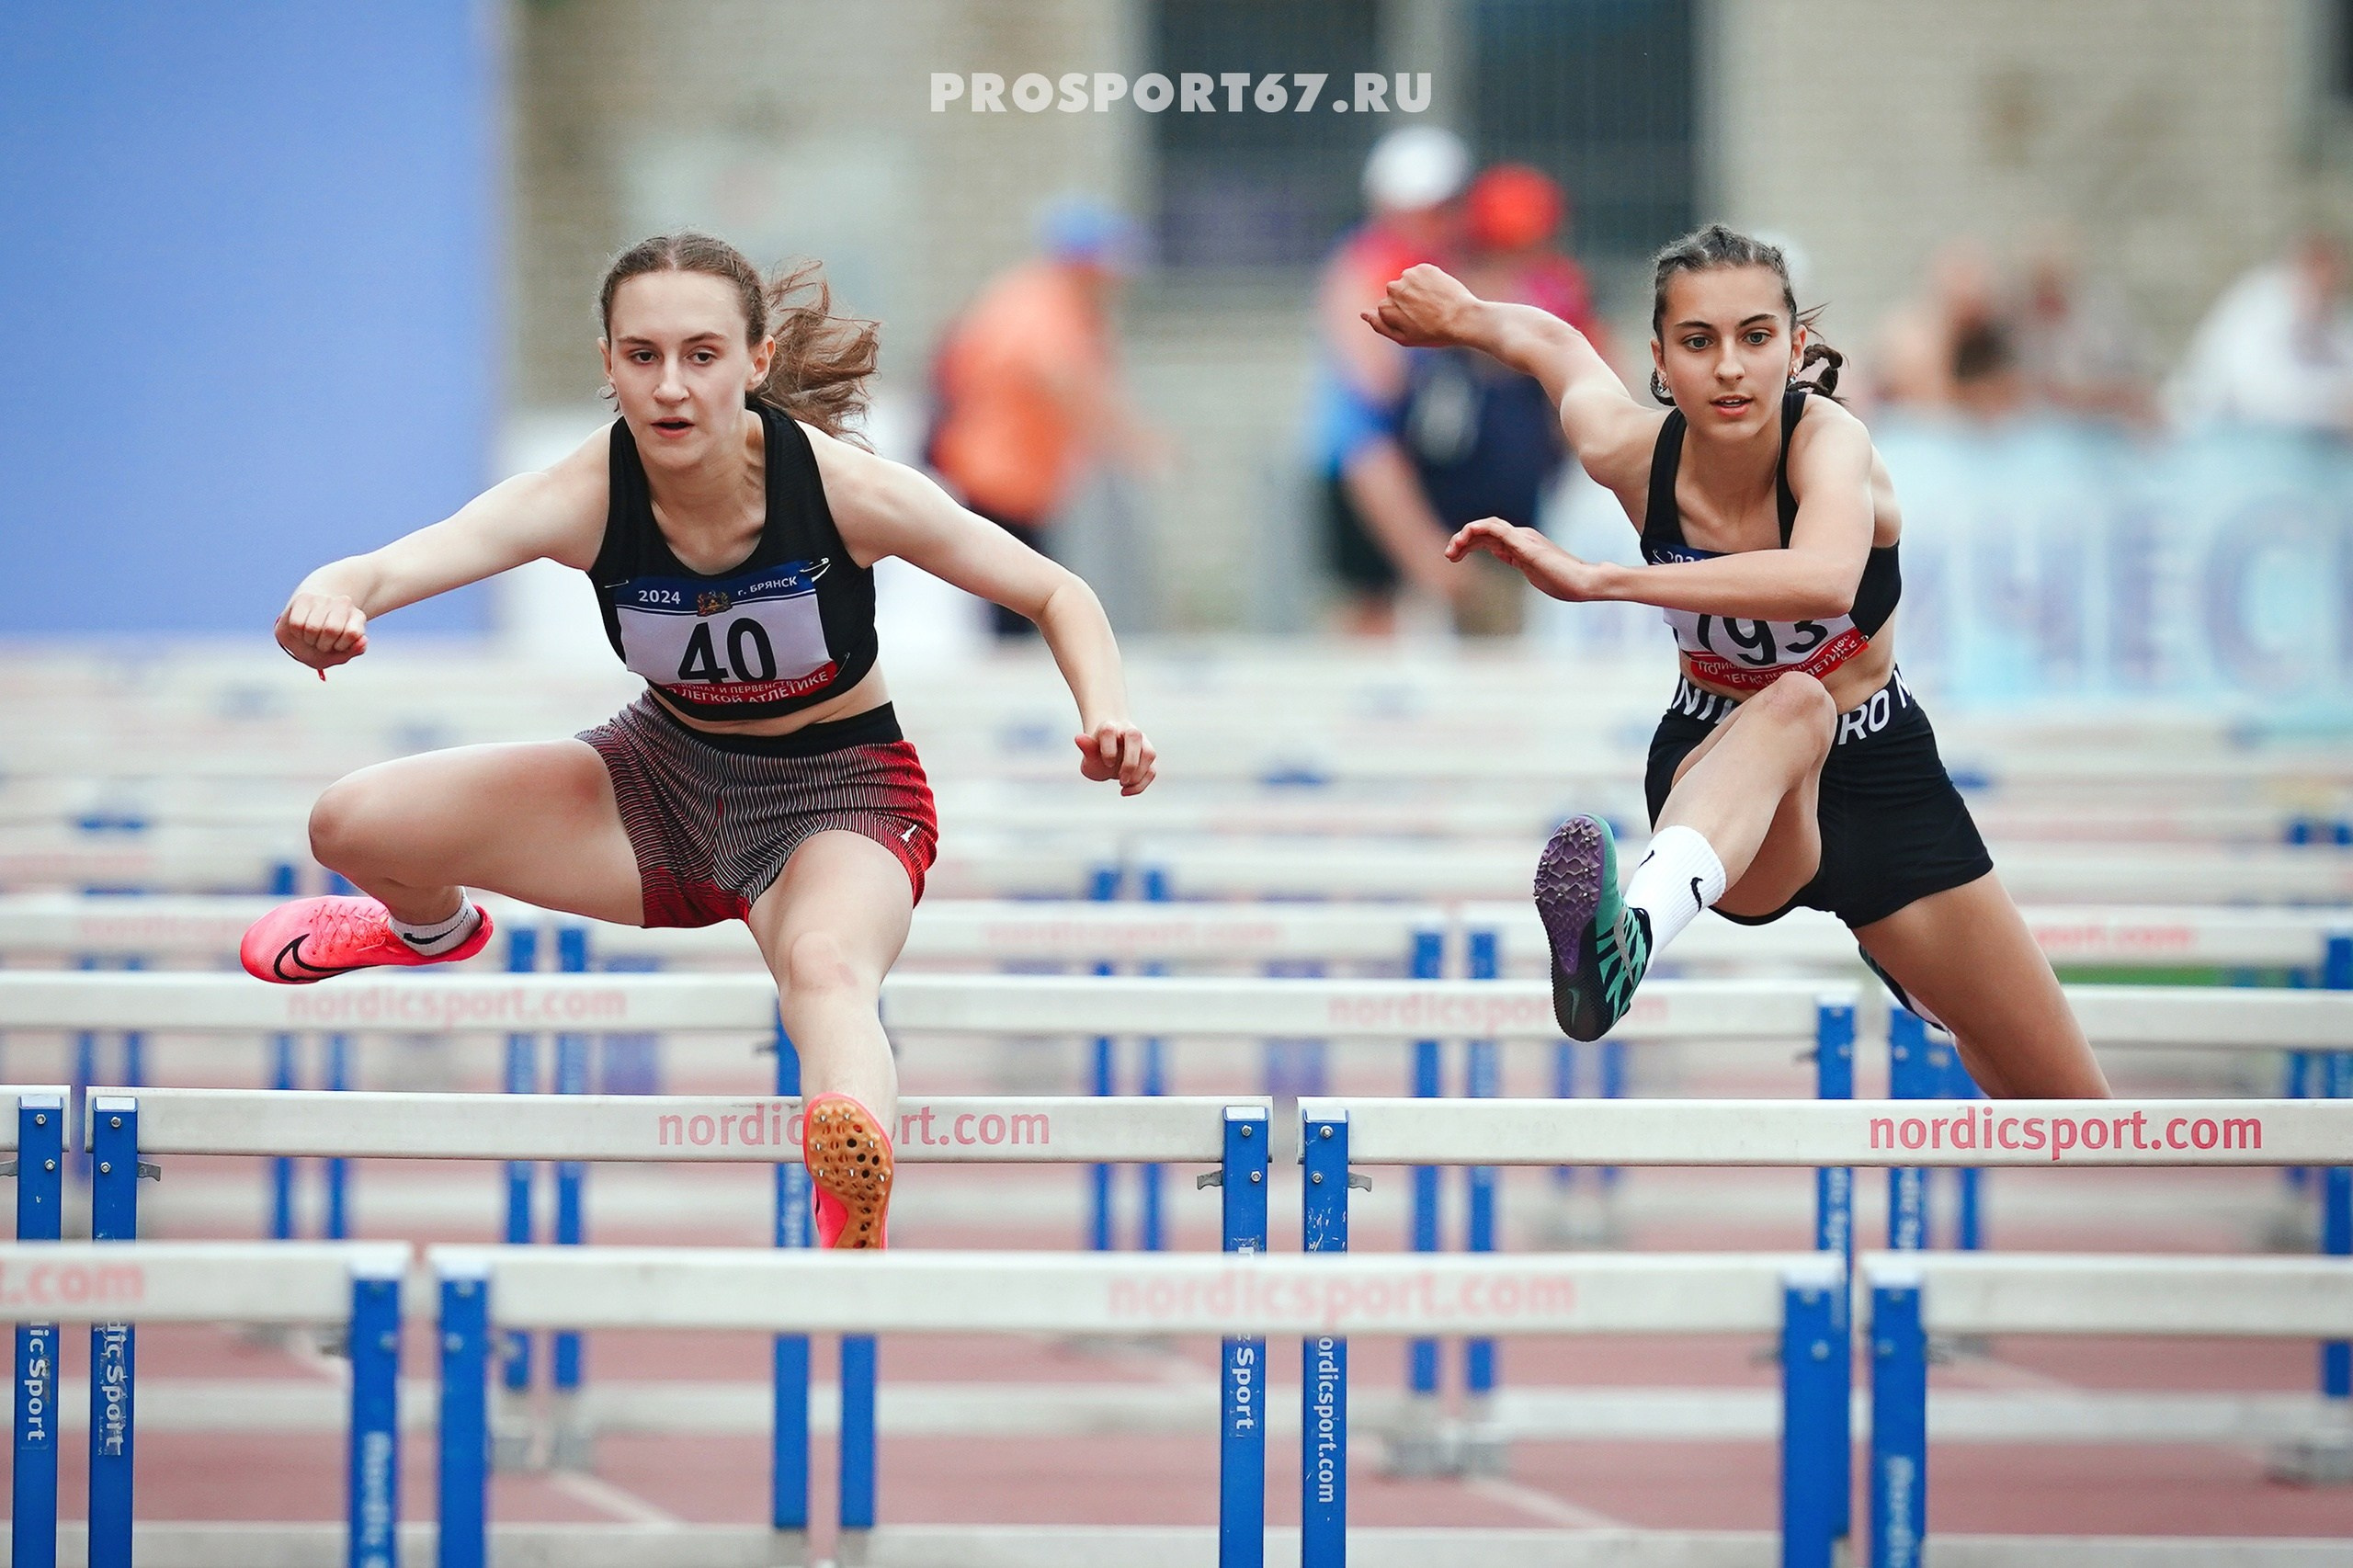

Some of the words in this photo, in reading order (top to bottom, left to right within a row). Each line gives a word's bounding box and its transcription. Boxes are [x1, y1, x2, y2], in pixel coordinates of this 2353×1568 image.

[638, 589, 681, 605] 2024
[749, 576, 798, 594] БРЯНСК
[677, 618, 778, 684] 40
[730, 680, 798, 694] ПЕРВЕНСТВ
[1837, 688, 1892, 745] RO
[658, 1103, 1050, 1147] nordicrt.com
[1870, 1106, 2263, 1162] nordicsport.com
[0, 1258, 146, 1306] .com
[24, 1358, 47, 1441] Sport
[102, 1365, 125, 1448] Sport
[1232, 1347, 1256, 1430] Sport
[1313, 1335, 1339, 1504] ordicsport.com
